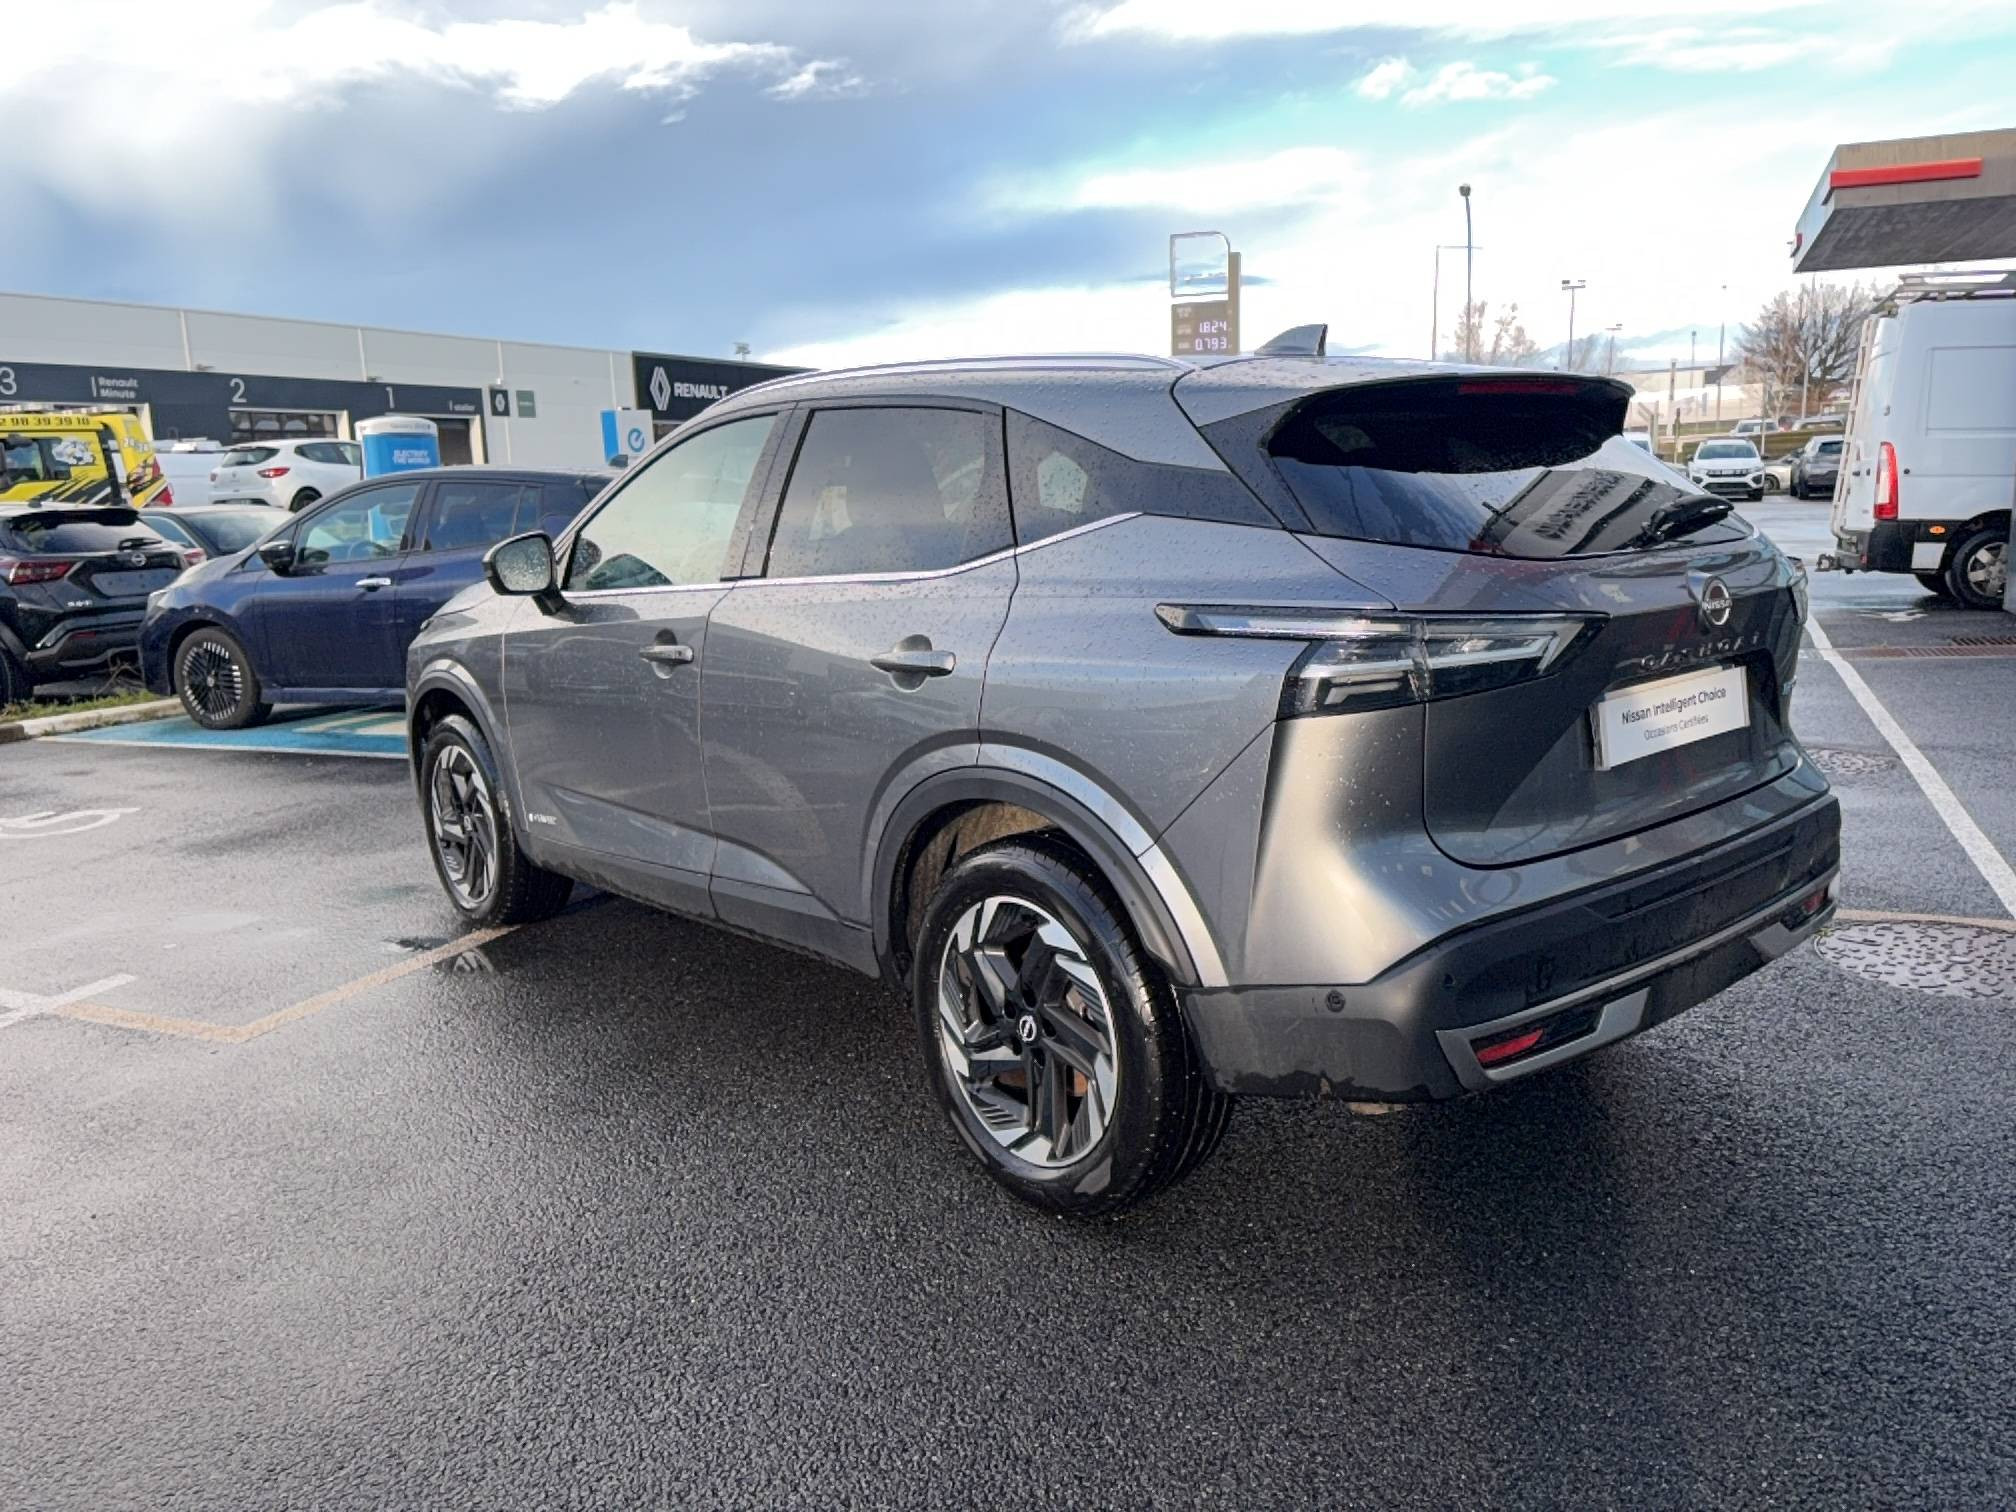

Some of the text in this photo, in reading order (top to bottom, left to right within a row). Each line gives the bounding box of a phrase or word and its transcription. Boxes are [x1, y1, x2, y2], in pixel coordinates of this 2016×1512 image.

[0, 366, 17, 395] 3
[98, 376, 139, 388] Renault
[230, 377, 248, 403] 2
[673, 381, 729, 400] RENAULT
[385, 386, 396, 409] 1
[1621, 686, 1727, 725] Nissan Intelligent Choice
[1643, 721, 1678, 741] Occasions
